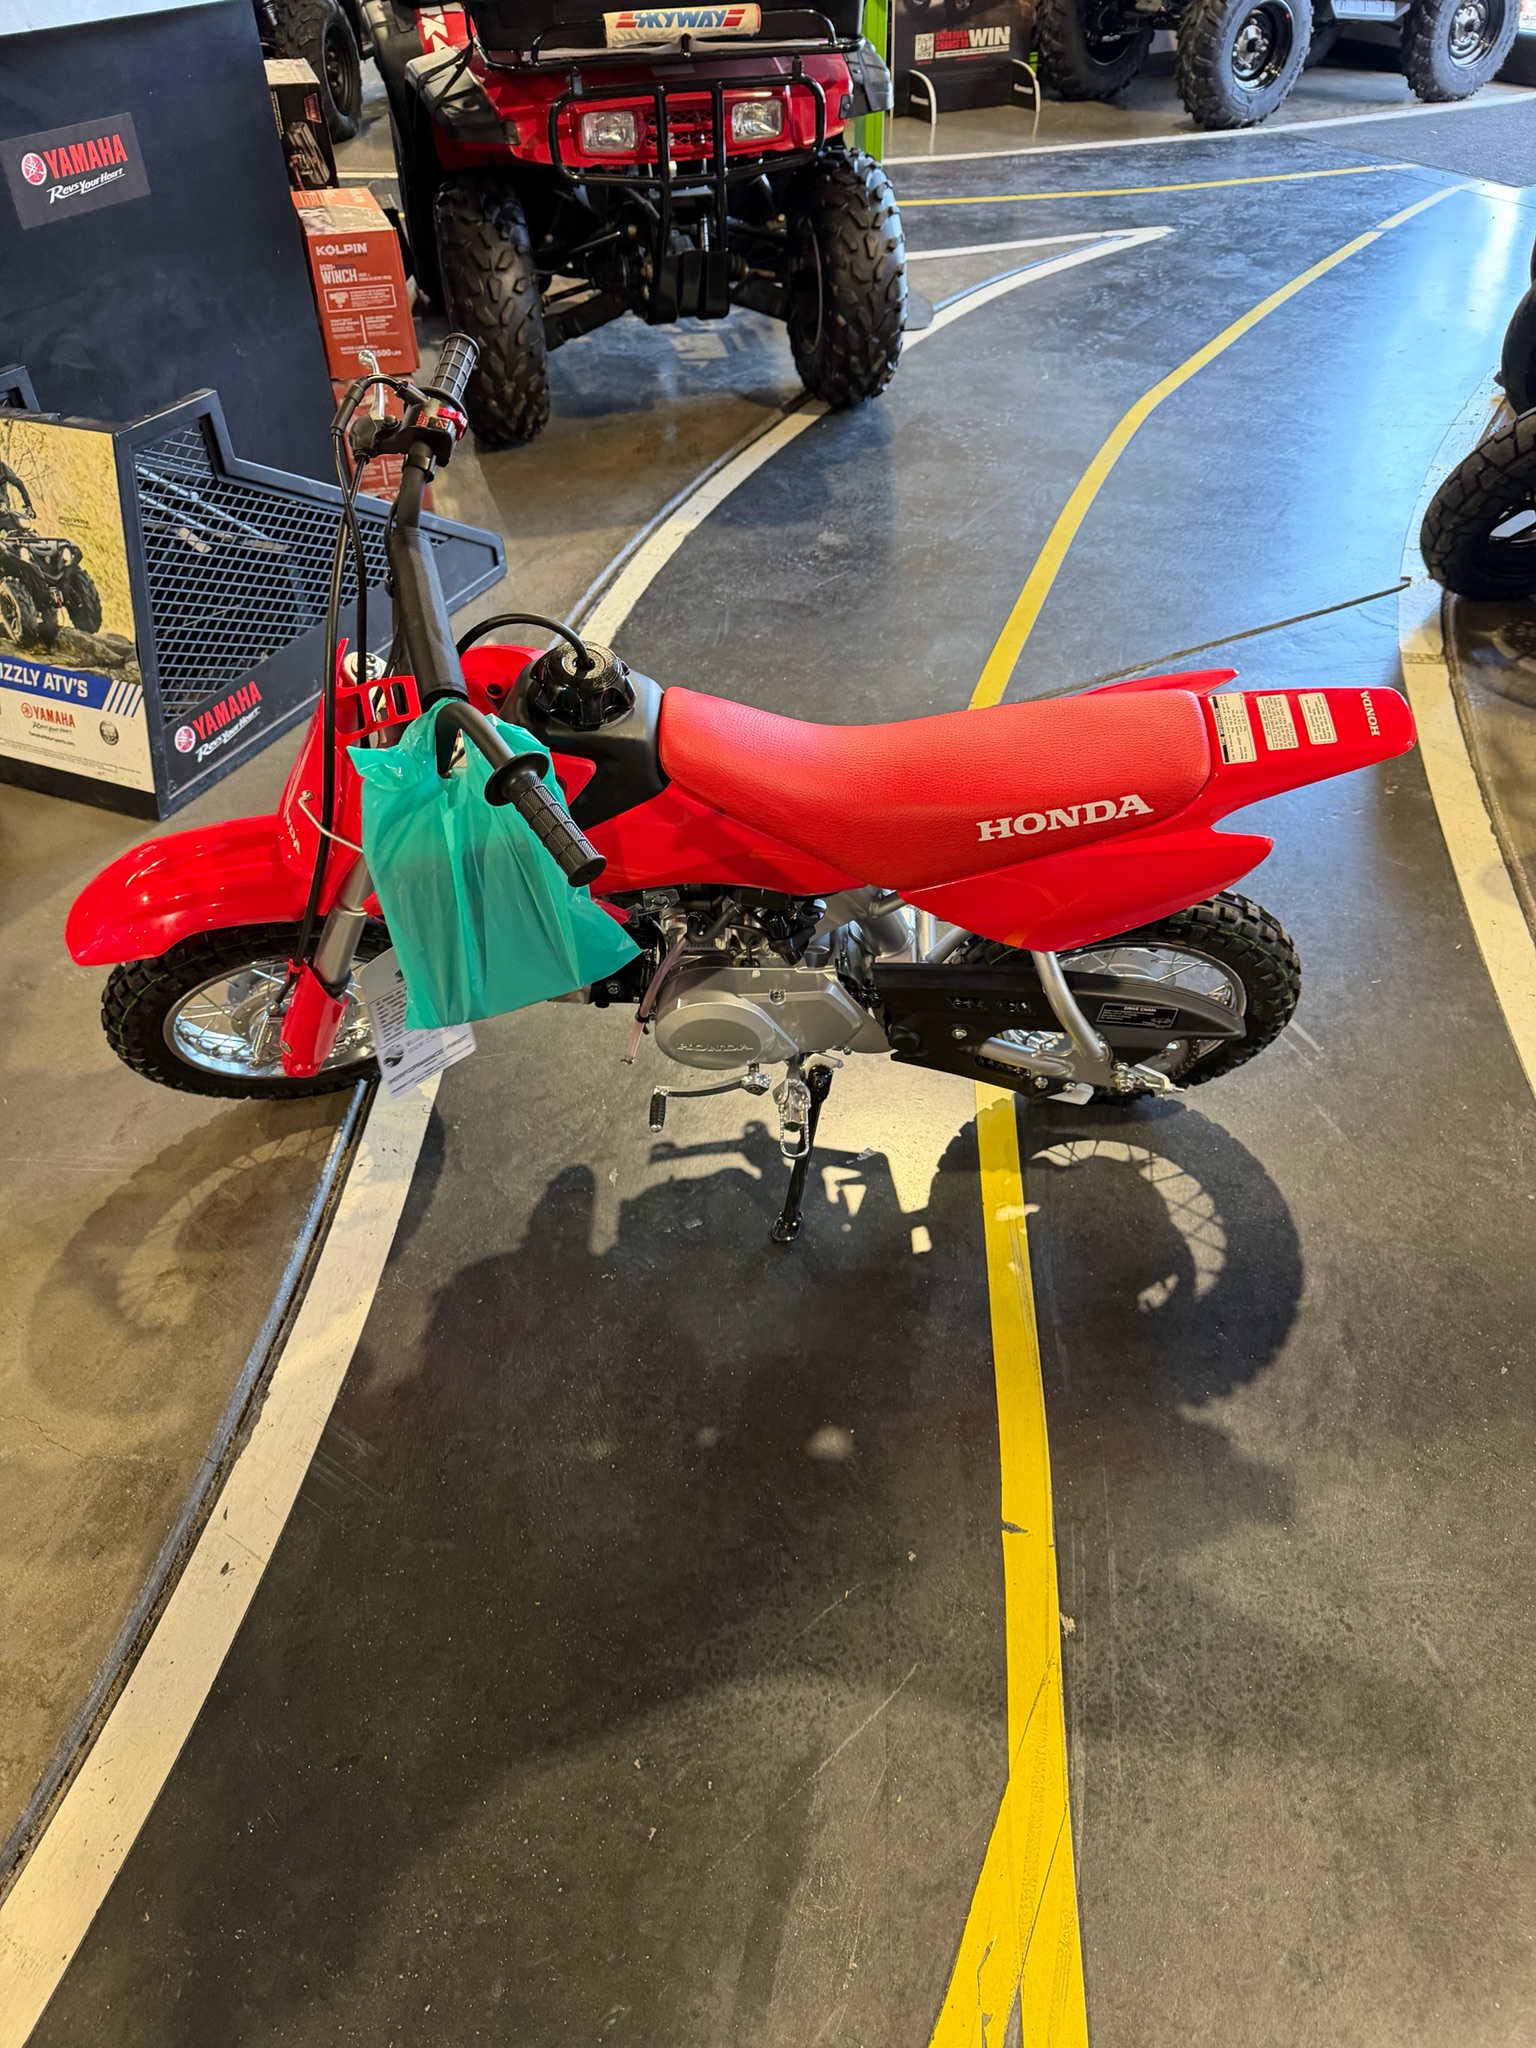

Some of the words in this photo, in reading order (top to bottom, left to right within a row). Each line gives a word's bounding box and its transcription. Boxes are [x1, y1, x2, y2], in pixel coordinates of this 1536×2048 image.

[634, 10, 727, 29] SKYWAY
[968, 26, 1011, 48] WIN
[42, 134, 129, 179] YAMAHA
[46, 180, 80, 204] Revs
[79, 176, 102, 195] Your
[100, 168, 125, 184] Heart
[314, 242, 368, 256] KOLPIN
[320, 268, 358, 285] WINCH
[43, 672, 89, 698] ATV'S
[32, 705, 76, 728] YAMAHA
[192, 680, 263, 741] YAMAHA
[1360, 690, 1381, 737] HONDA
[195, 735, 224, 763] Revs
[976, 793, 1154, 842] HONDA
[677, 1043, 755, 1052] HONDA
